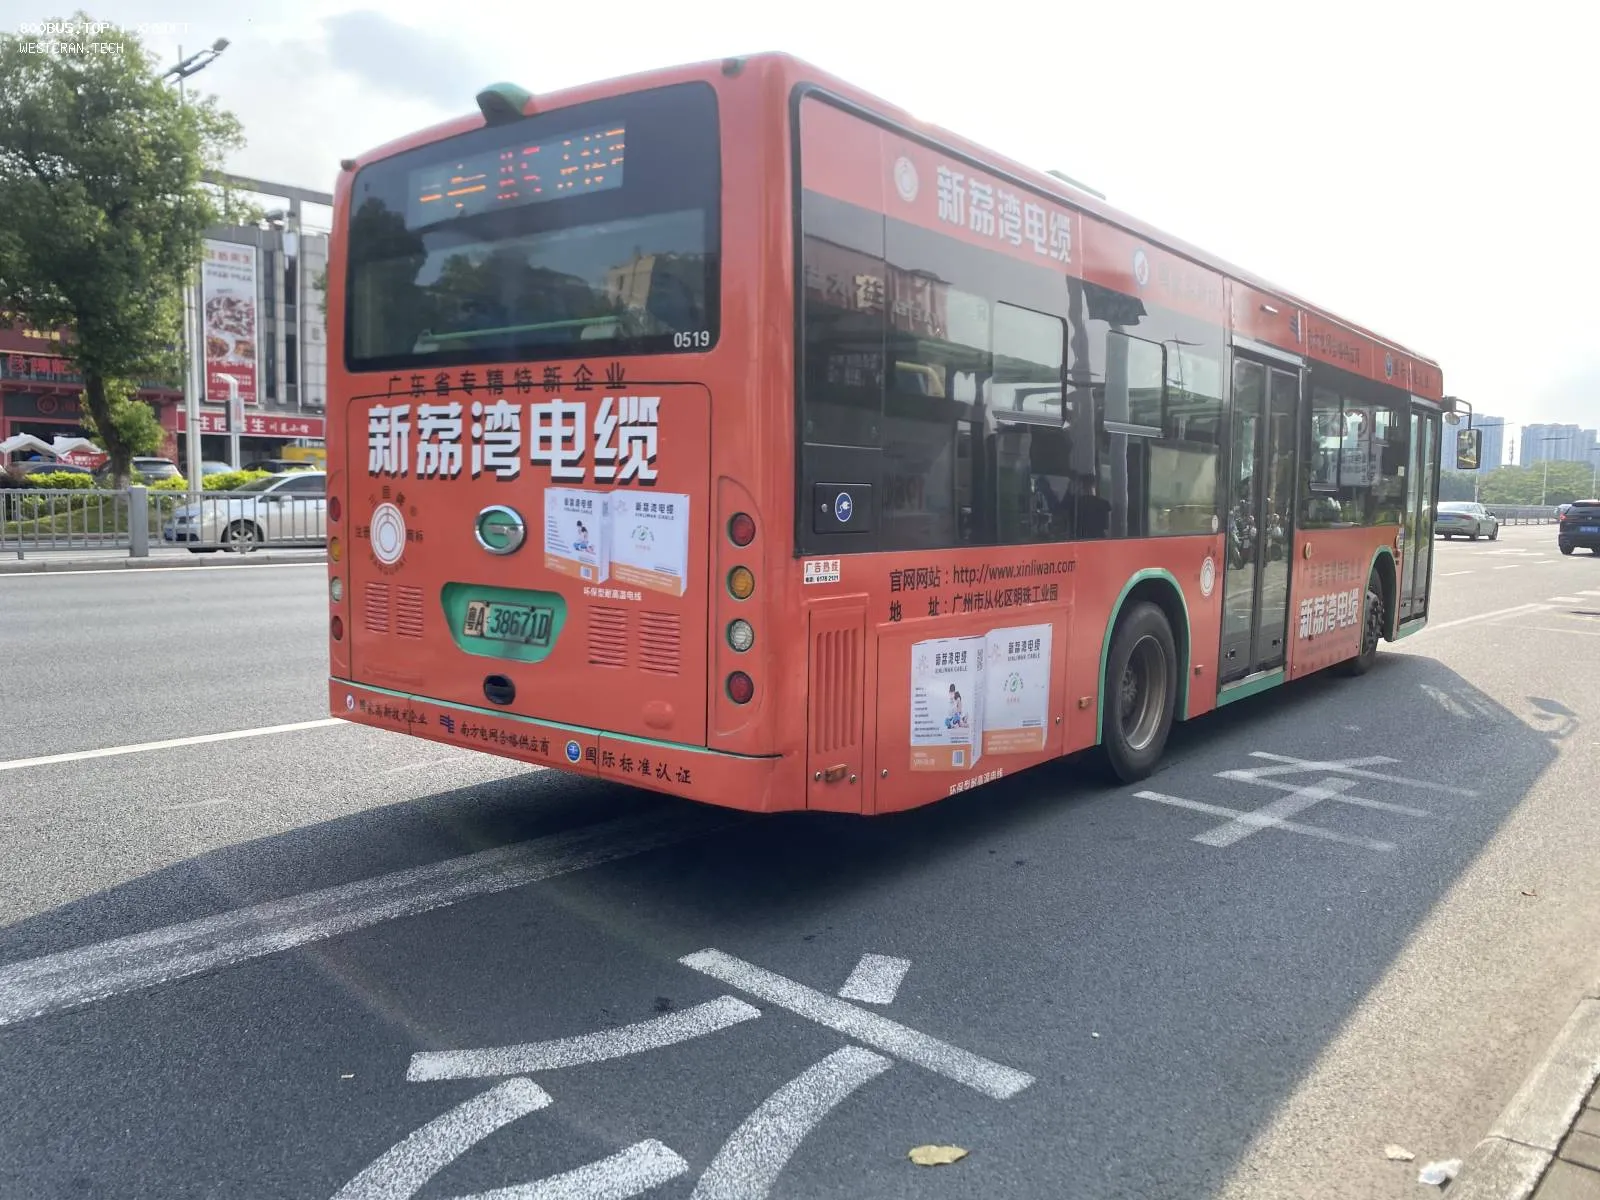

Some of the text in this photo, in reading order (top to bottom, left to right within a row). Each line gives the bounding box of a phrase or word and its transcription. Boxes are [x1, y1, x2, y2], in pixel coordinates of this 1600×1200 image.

[936, 164, 1071, 266] 新荔湾电缆
[674, 330, 710, 348] 0519
[386, 361, 627, 399] 广东省专精特新企业
[367, 396, 662, 484] 新荔湾电缆
[583, 586, 642, 602] 环保型耐高温电线
[1300, 587, 1360, 639] 新荔湾电缆
[459, 720, 550, 757] 南方电网合格供应商
[585, 746, 693, 785] 国际标准认证
